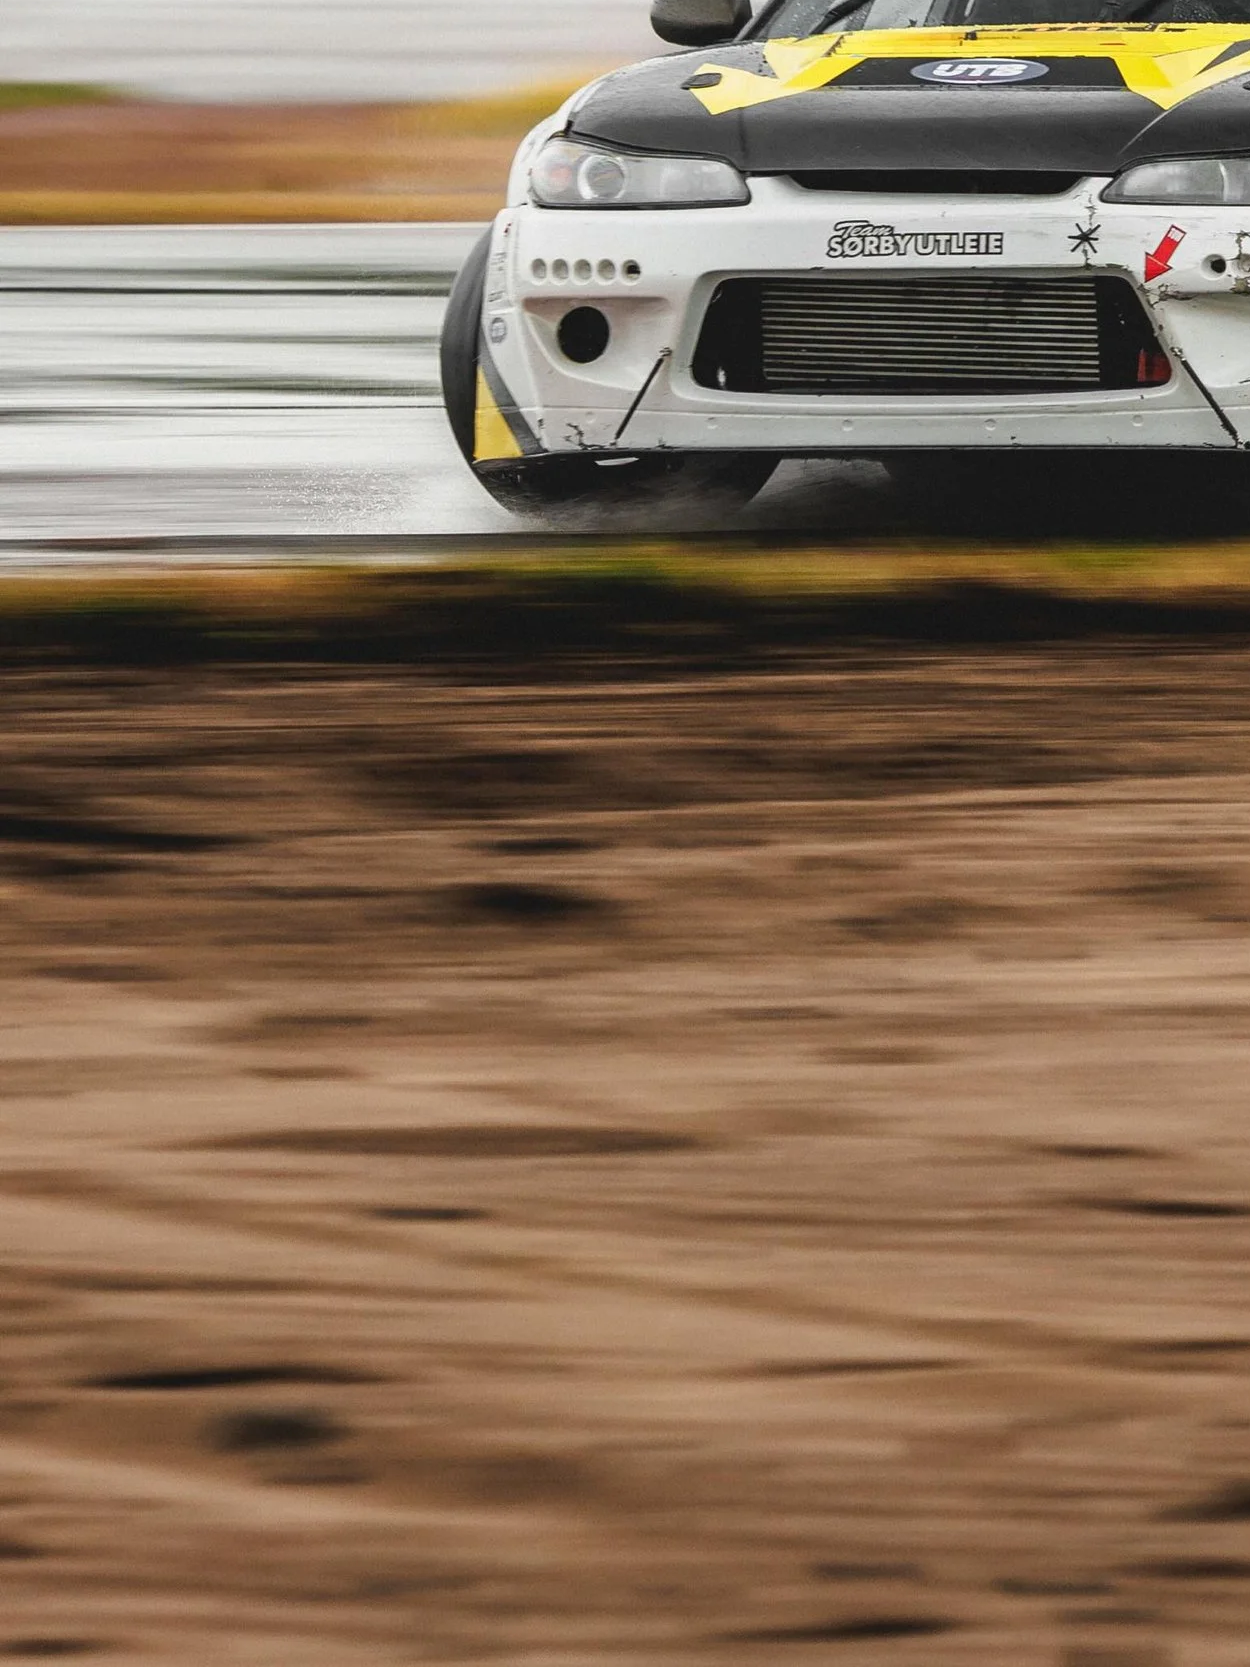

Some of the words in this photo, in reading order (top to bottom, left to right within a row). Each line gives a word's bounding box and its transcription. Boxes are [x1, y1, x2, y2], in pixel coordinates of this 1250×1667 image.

[932, 63, 1028, 77] UTB
[834, 220, 894, 238] Team
[826, 234, 911, 259] SØRBY
[913, 232, 1003, 257] UTLEIE
